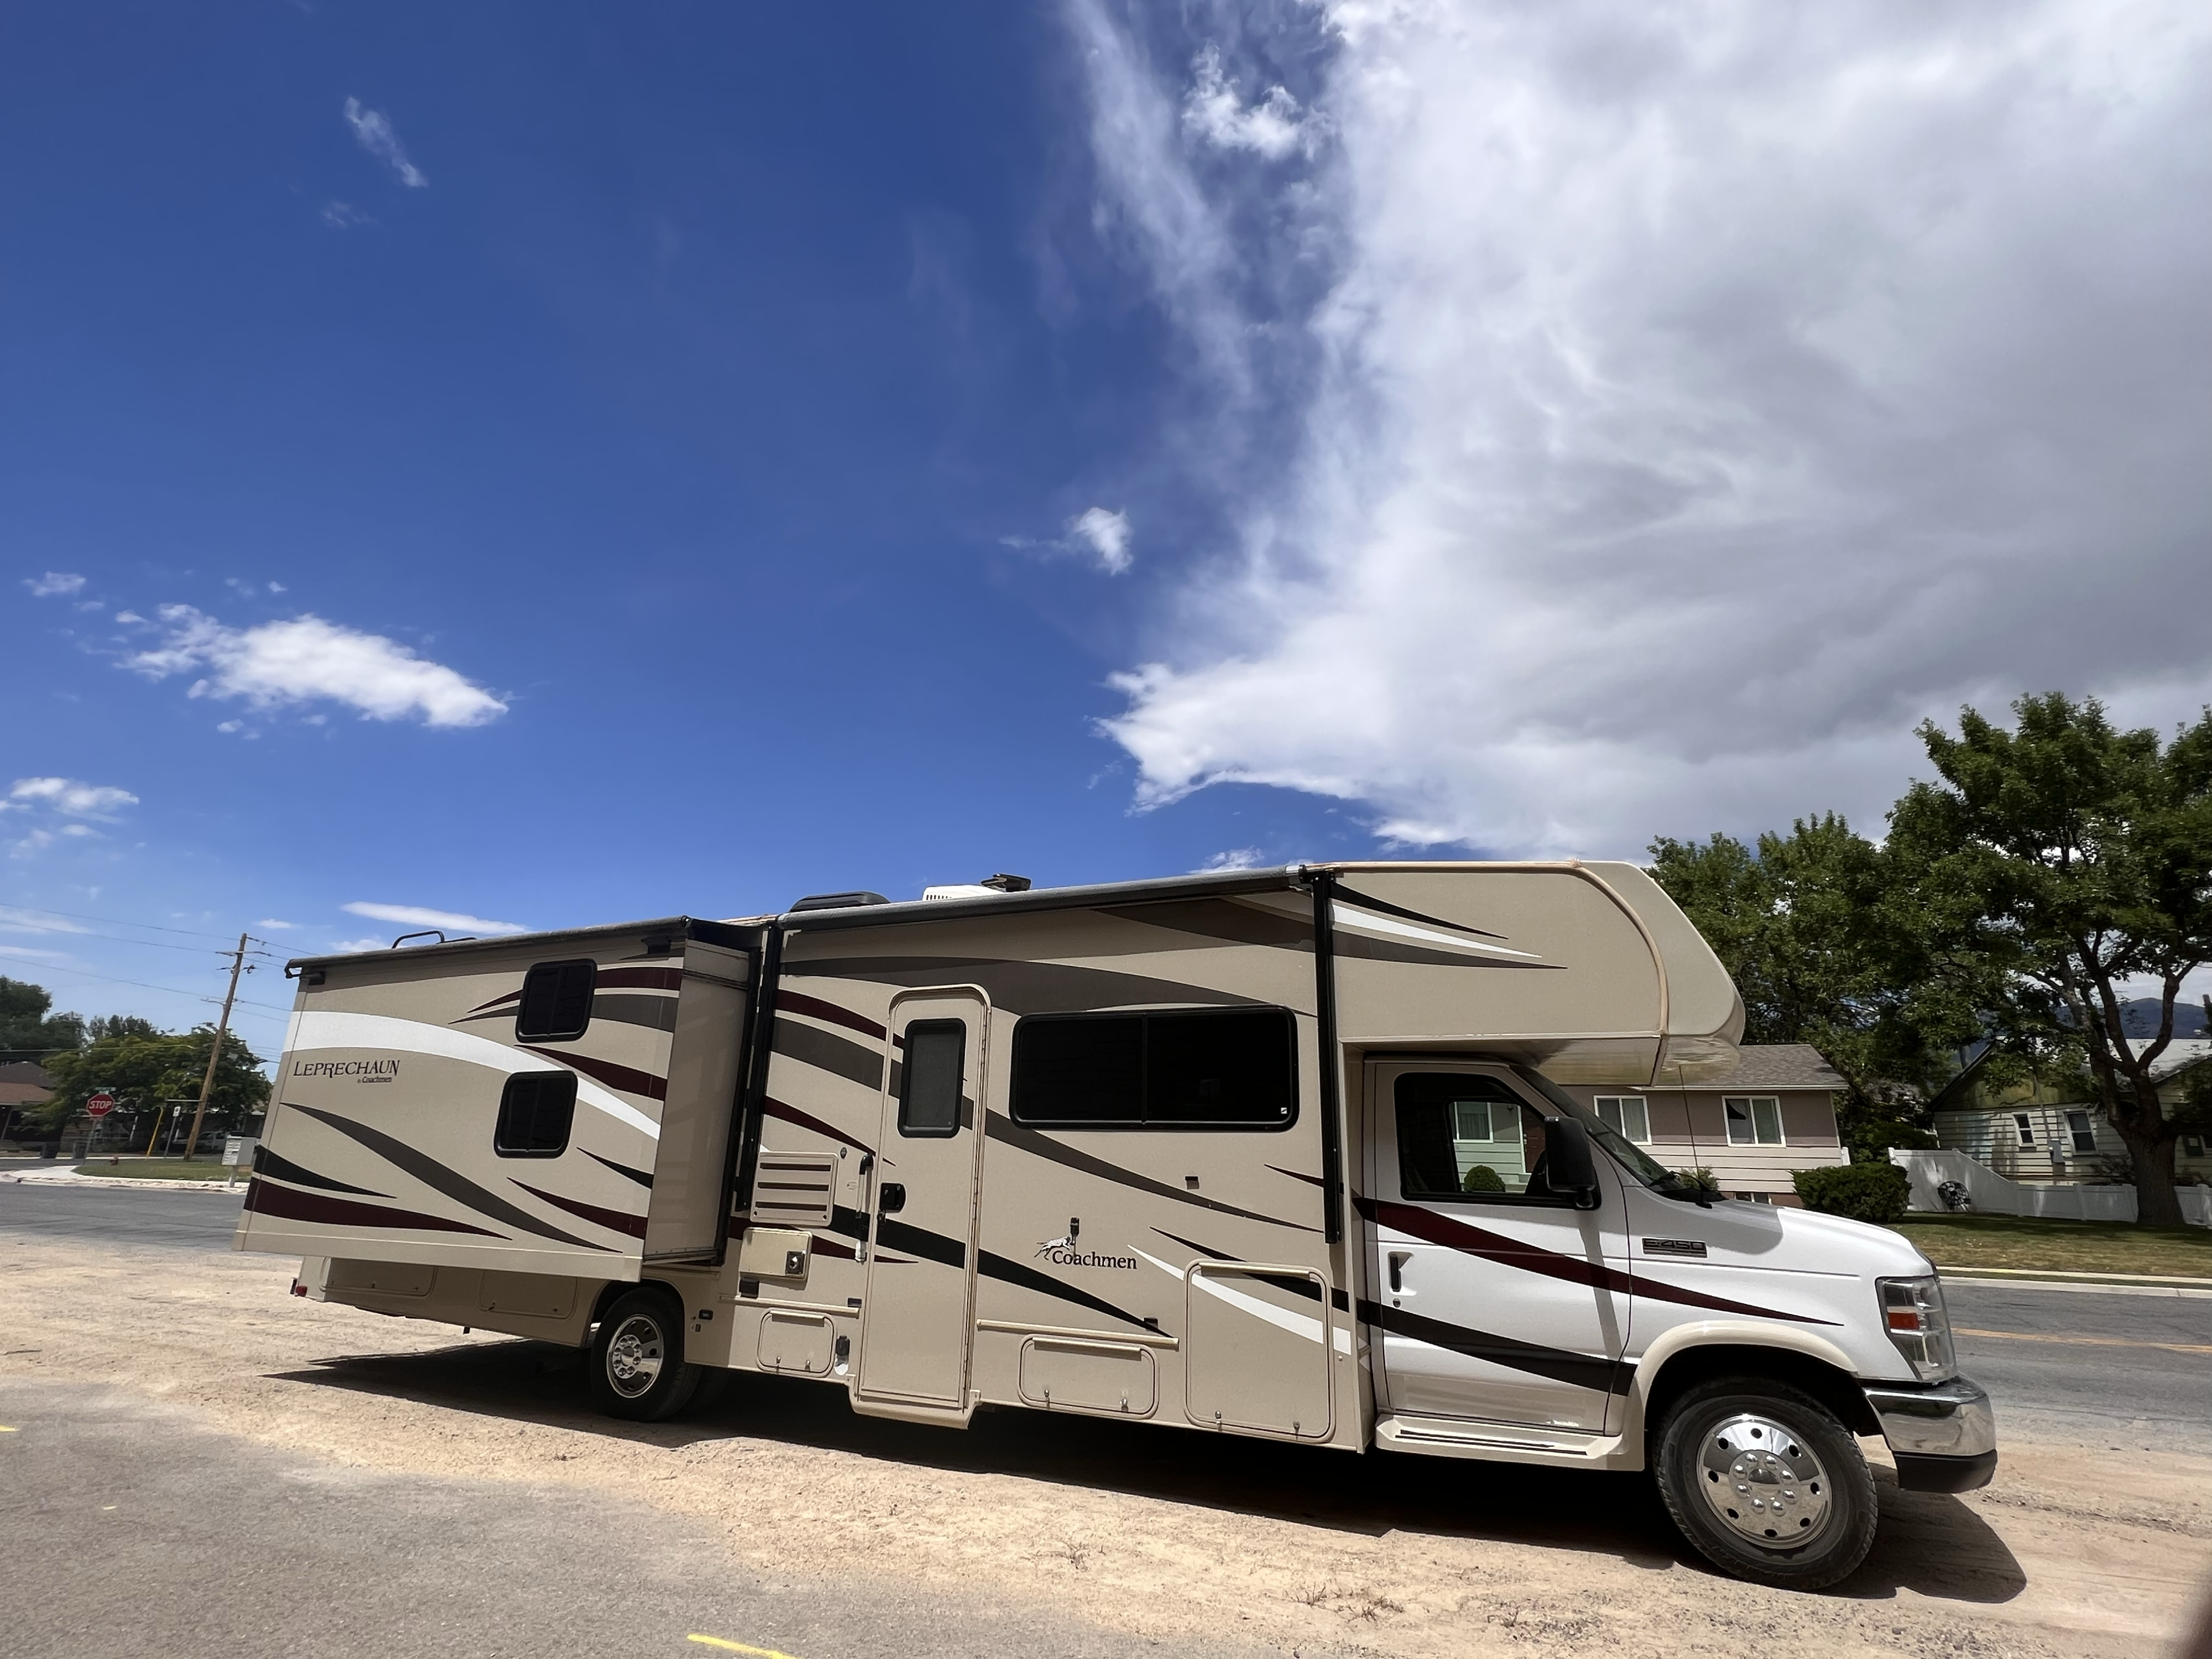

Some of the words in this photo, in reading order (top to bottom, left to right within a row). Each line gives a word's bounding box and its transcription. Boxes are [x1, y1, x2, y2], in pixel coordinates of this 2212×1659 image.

[293, 1060, 400, 1078] LEPRECHAUN
[88, 1100, 112, 1109] STOP
[1052, 1250, 1138, 1270] Coachmen
